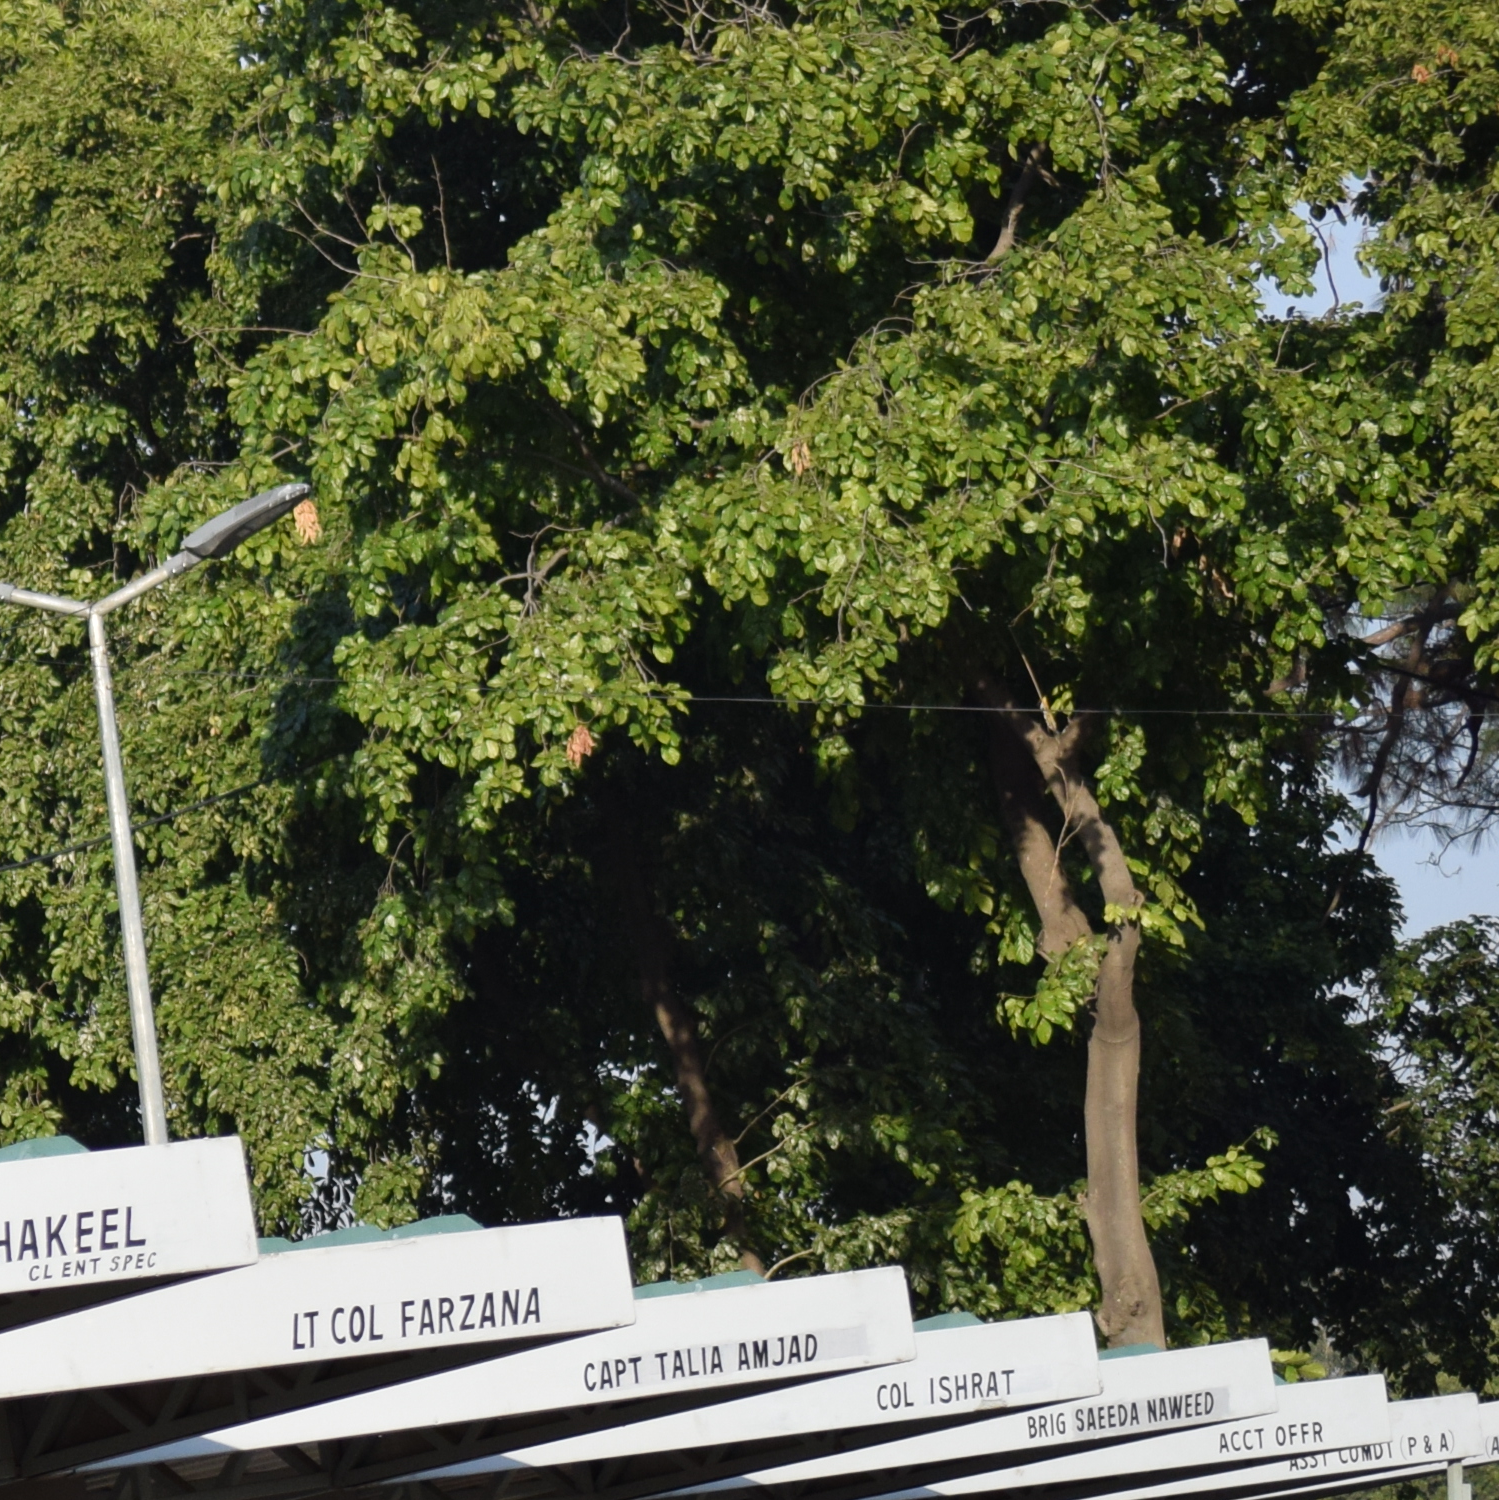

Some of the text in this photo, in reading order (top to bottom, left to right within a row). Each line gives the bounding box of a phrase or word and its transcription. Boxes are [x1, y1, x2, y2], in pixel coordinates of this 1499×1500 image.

[109, 1251, 157, 1272] SPEC
[292, 1287, 541, 1351] LT COL FARZANA
[583, 1333, 818, 1392] CAPT TALIA AMJAD
[876, 1369, 1015, 1411] COL ISHRAT
[1027, 1391, 1215, 1440] BRIG SAEEDA NAWEED
[1219, 1421, 1323, 1454] ACCT OFFR
[1422, 1434, 1434, 1455] &
